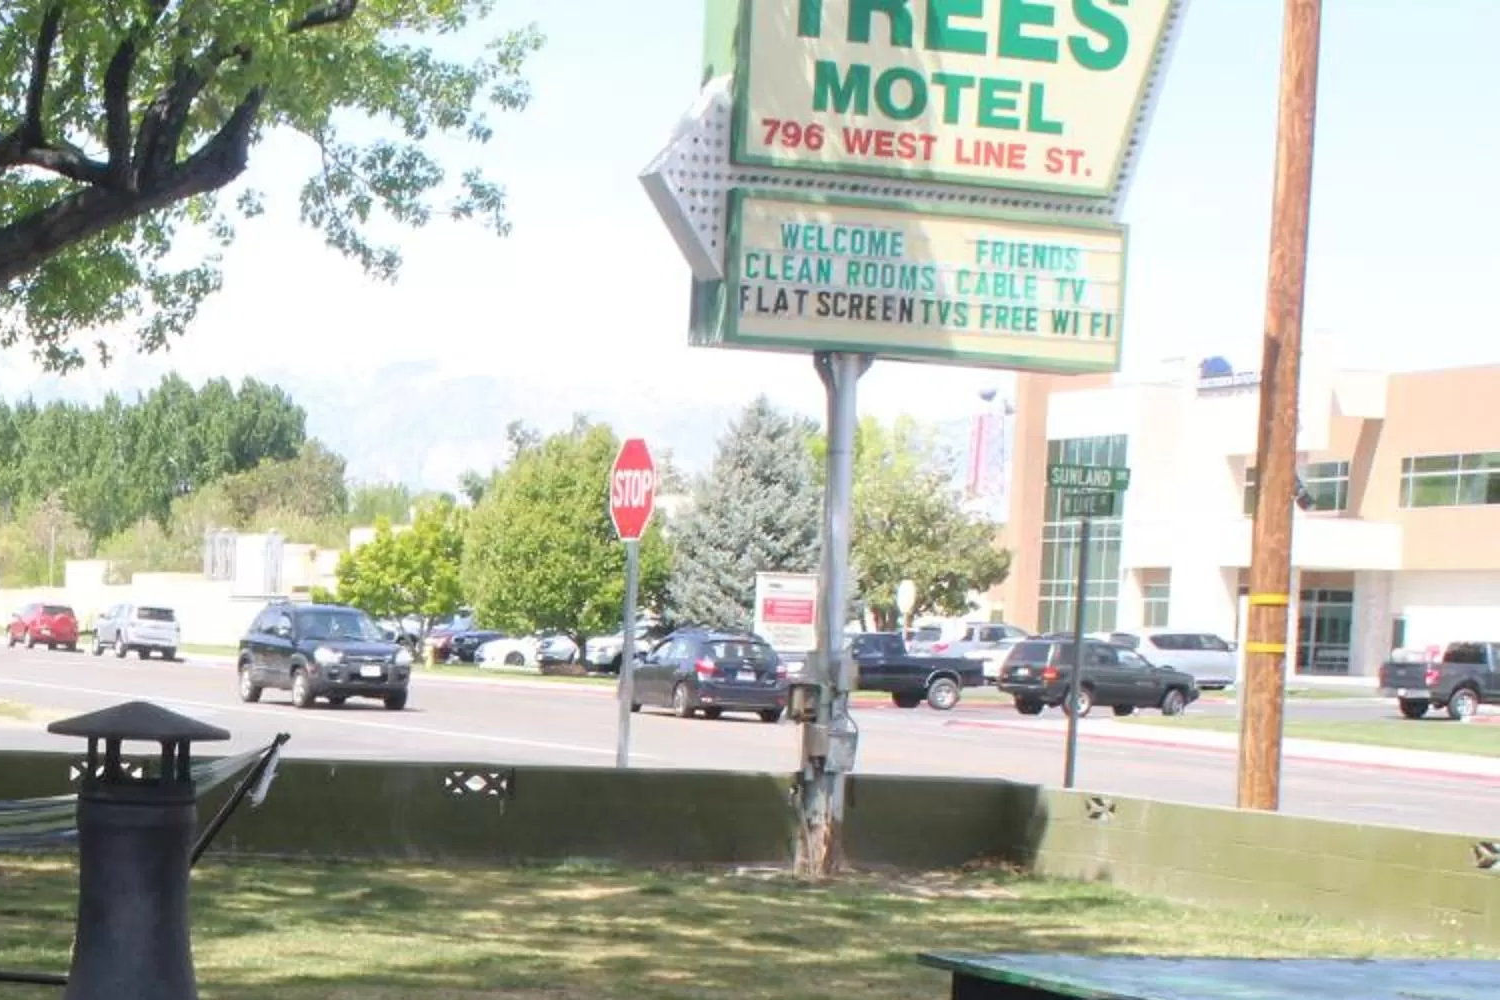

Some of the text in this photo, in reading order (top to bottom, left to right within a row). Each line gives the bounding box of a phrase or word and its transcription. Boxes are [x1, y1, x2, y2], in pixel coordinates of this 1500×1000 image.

[812, 59, 1064, 135] MOTEL
[762, 118, 1092, 176] 796 WEST LINE ST.
[781, 223, 1080, 272] WELCOME FRIENDS
[746, 252, 1087, 304] CLEAN ROOMS CABLE TV
[740, 285, 809, 316] FLAT
[815, 291, 915, 324] SCREEN
[920, 299, 969, 328] TVS
[980, 304, 1038, 332] FREE
[614, 469, 652, 508] STOP
